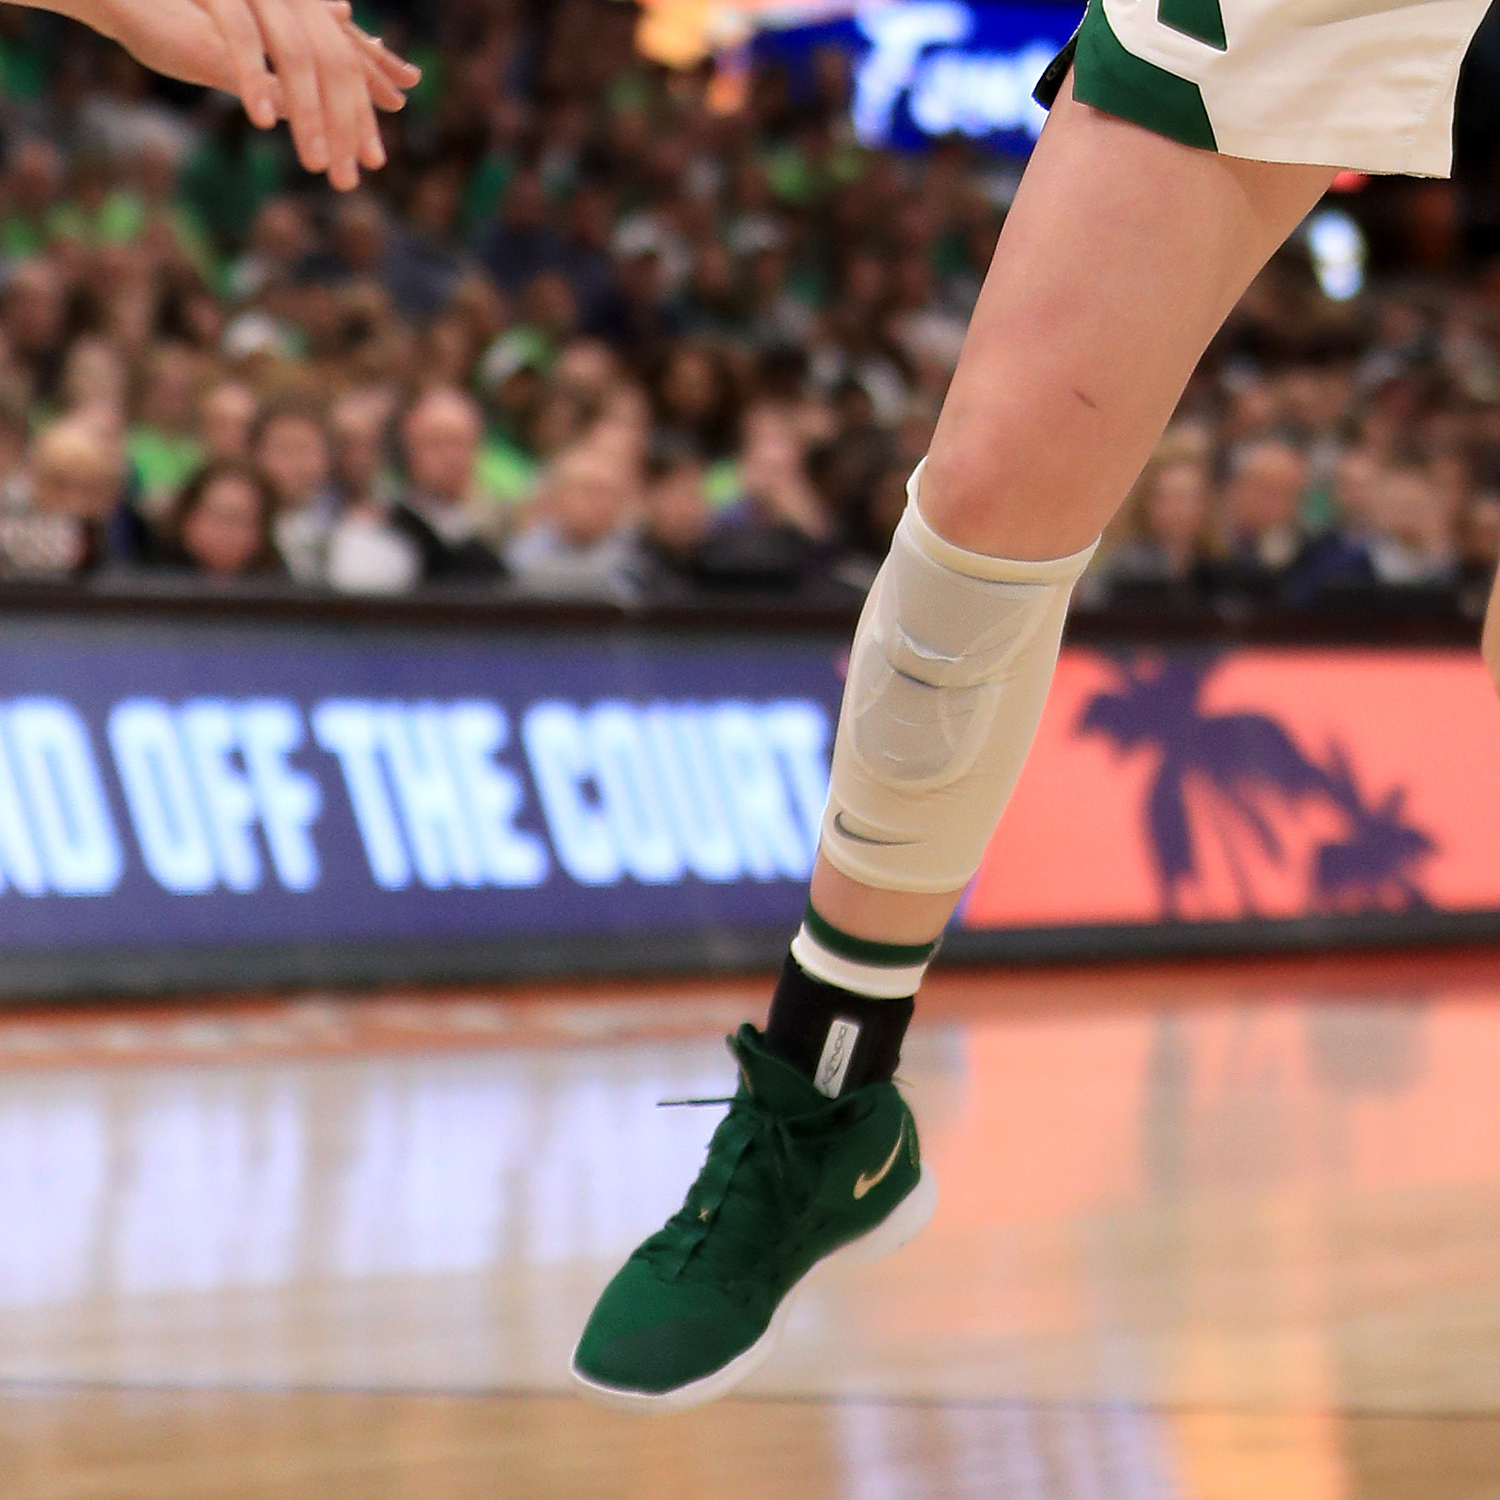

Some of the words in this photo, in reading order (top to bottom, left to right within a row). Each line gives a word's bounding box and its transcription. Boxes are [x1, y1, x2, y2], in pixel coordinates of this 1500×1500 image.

[107, 698, 320, 894] OFF
[311, 700, 548, 890] THE
[522, 702, 828, 884] COURT
